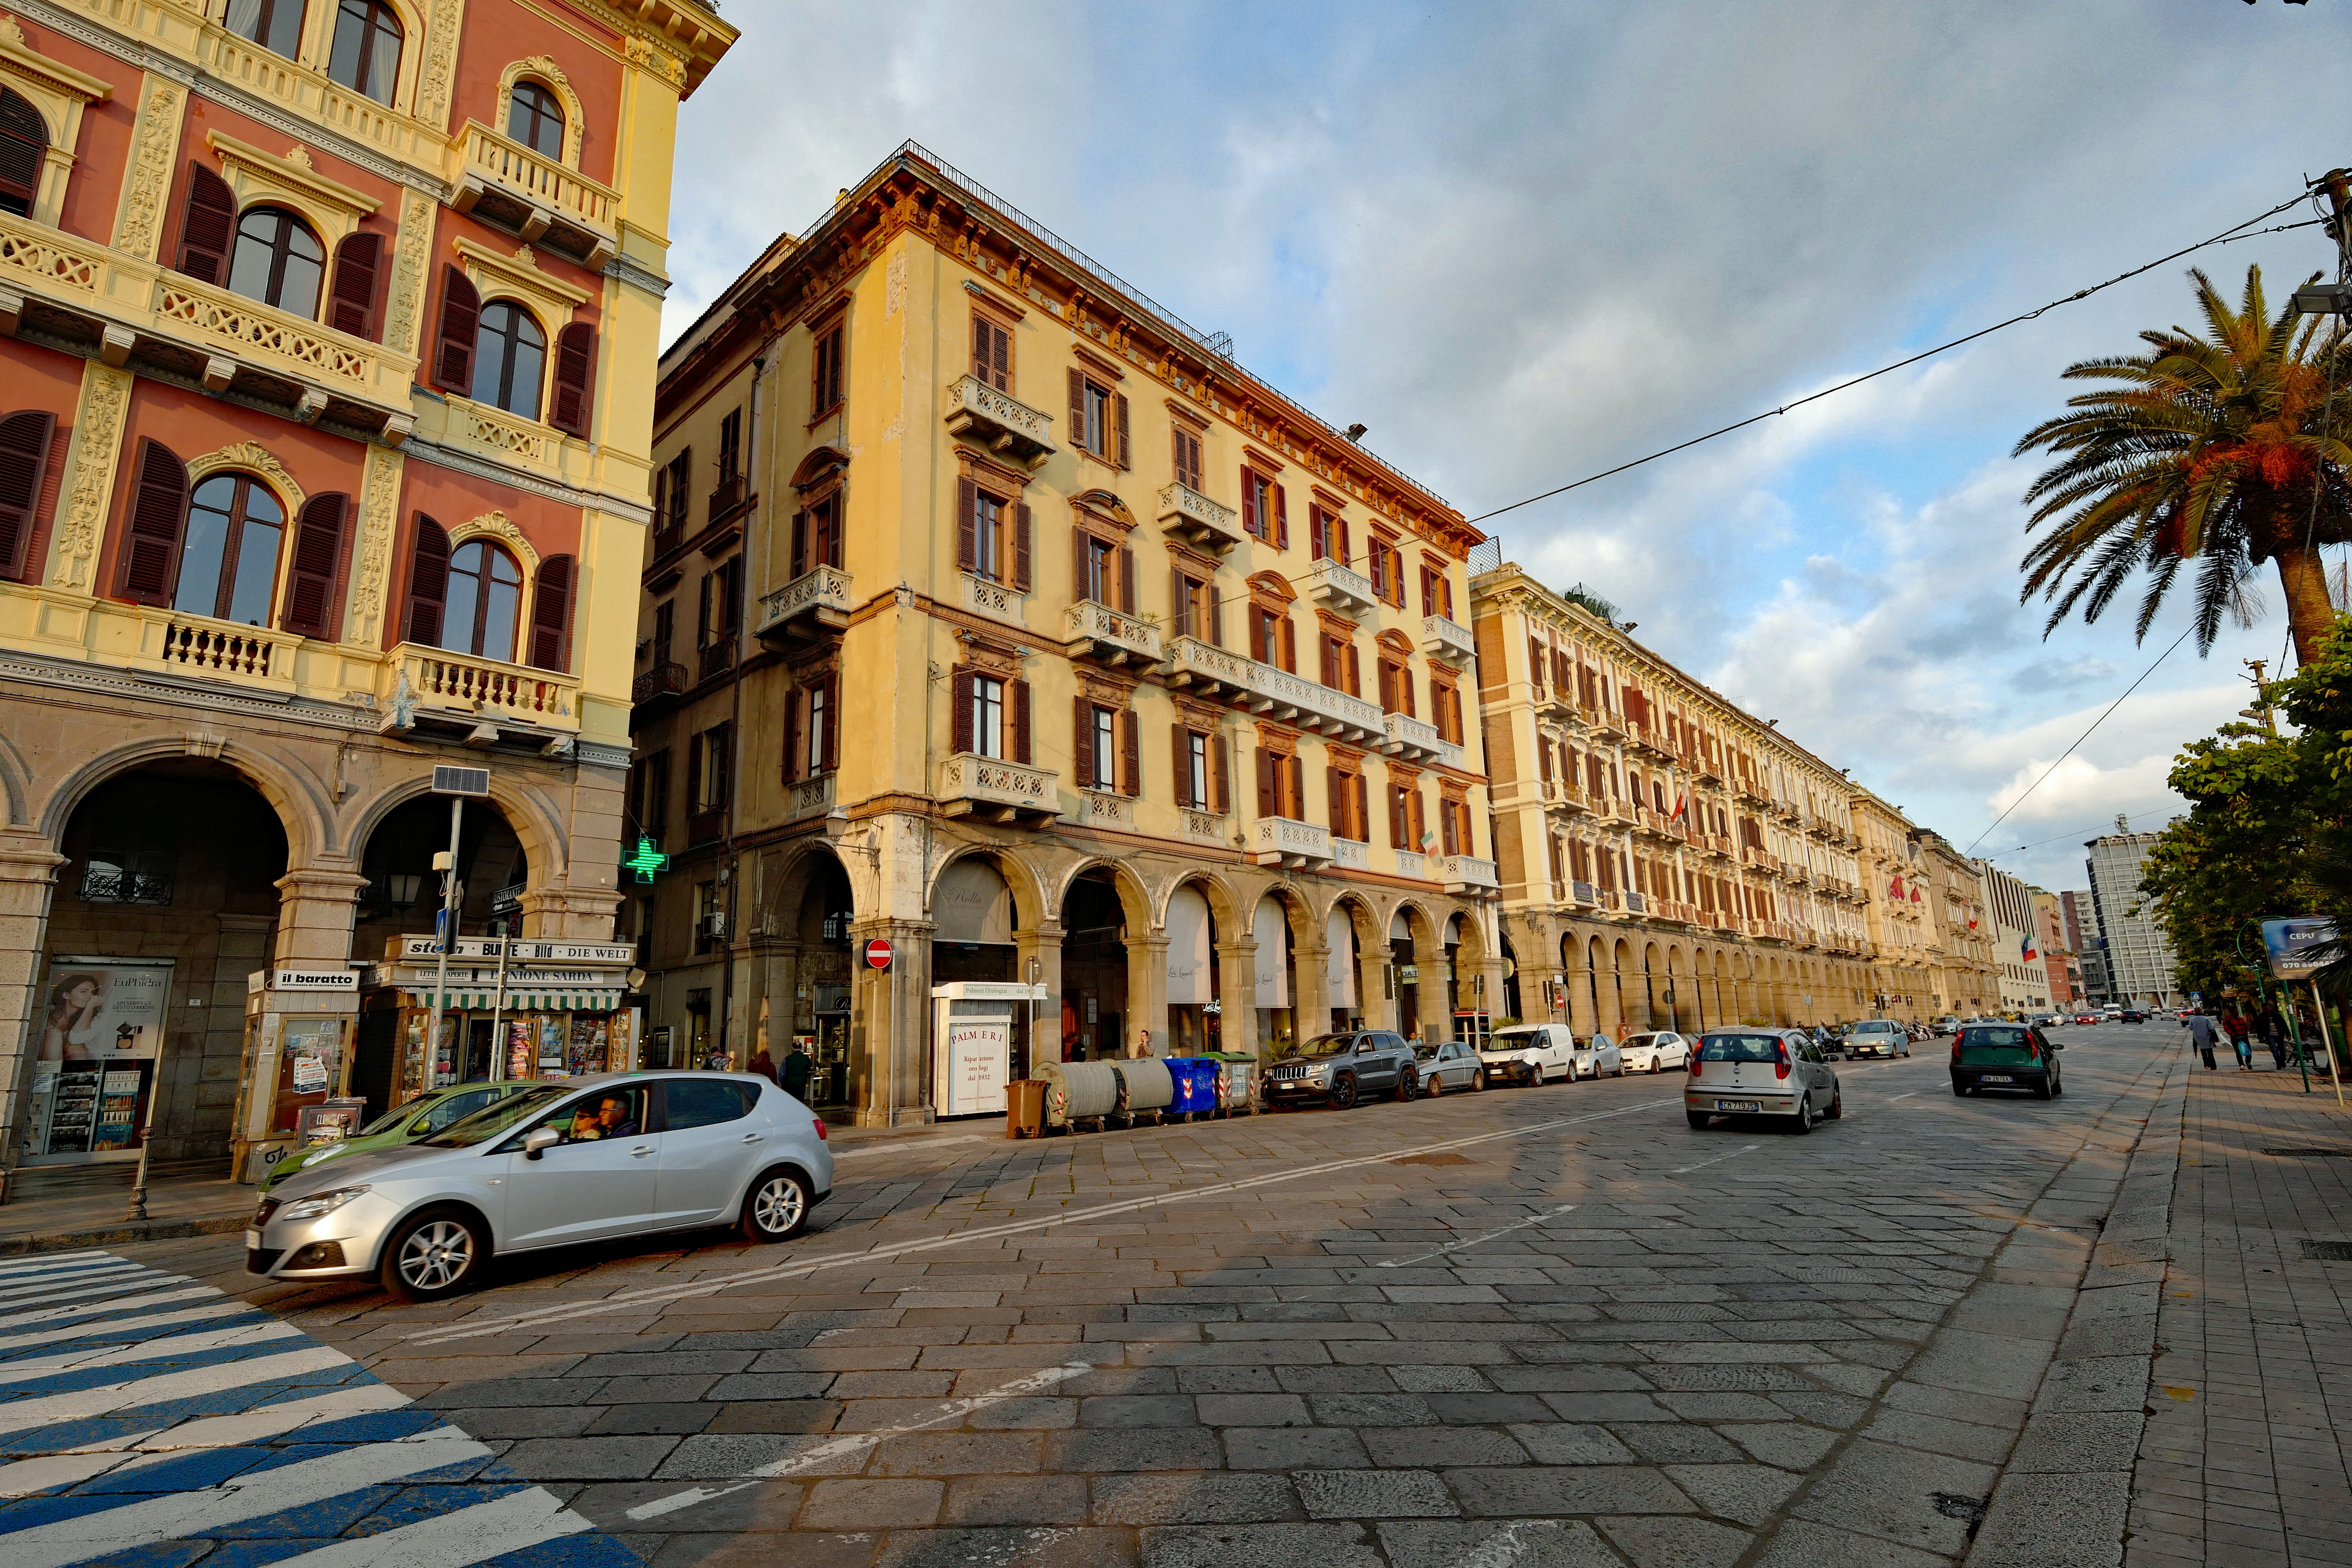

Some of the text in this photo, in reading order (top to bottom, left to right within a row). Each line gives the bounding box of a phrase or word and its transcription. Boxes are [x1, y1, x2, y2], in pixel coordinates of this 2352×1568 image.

[493, 887, 521, 904] RISTORANTE
[948, 886, 982, 904] Rolla
[535, 945, 552, 958] Bild
[568, 948, 590, 957] DIE
[595, 949, 628, 958] WELT
[114, 978, 161, 987] EuPhidra
[282, 974, 352, 984] il baratto
[553, 972, 593, 981] SARDA
[951, 1031, 1003, 1044] PALMERI
